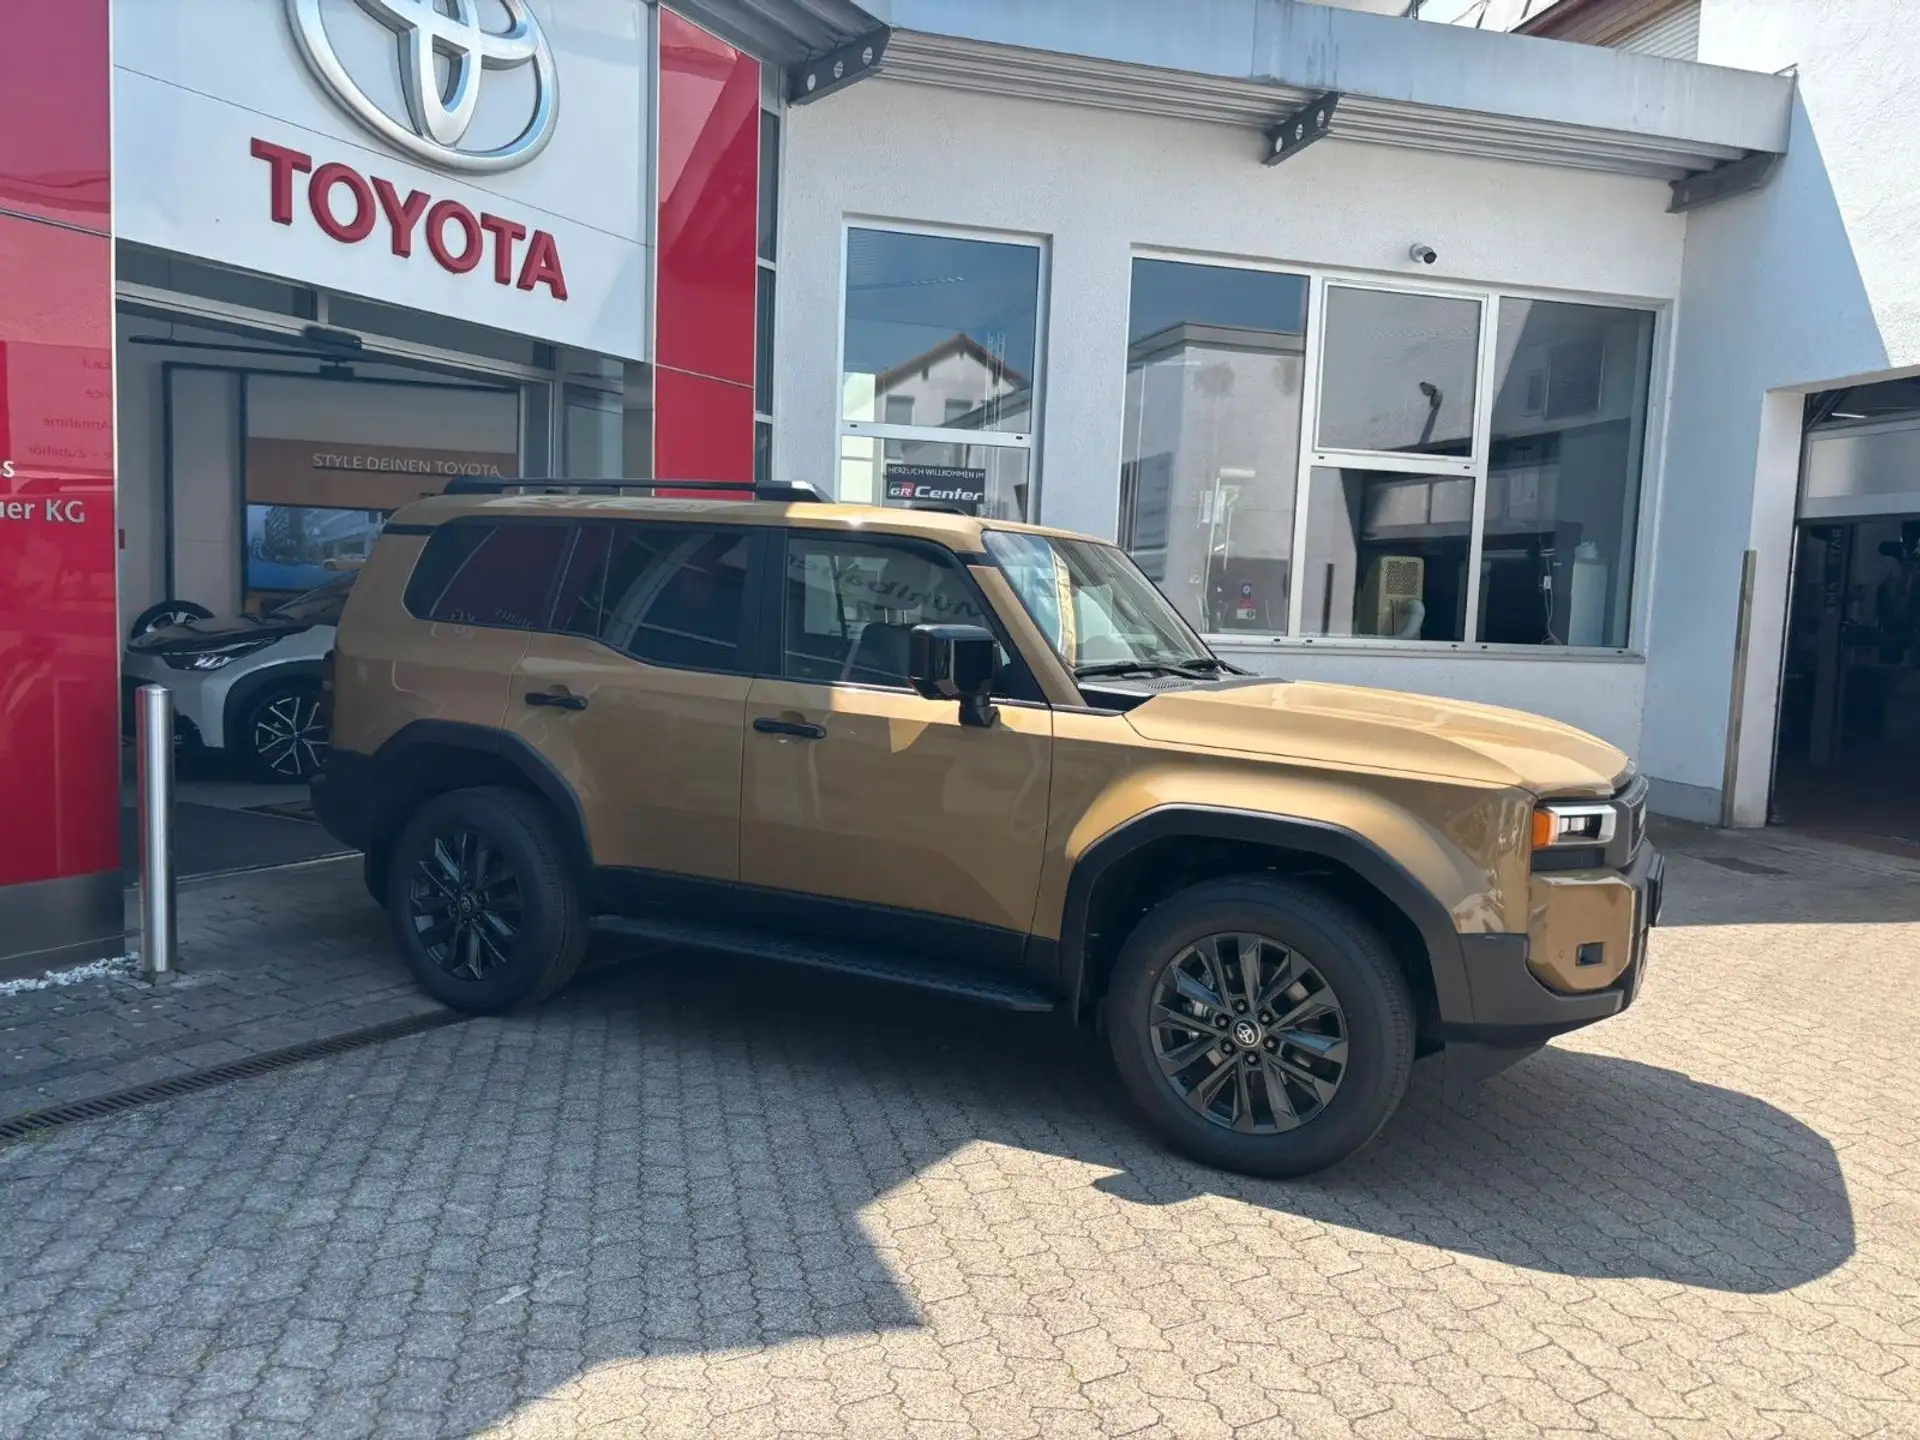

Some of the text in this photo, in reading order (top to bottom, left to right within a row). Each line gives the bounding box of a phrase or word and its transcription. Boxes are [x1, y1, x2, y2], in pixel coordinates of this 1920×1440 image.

[250, 137, 569, 302] TOYOTA
[312, 453, 501, 476] STYLE DEINEN TOYOTA
[888, 466, 985, 479] HERZLICH WILLKOMMEN IM
[890, 485, 984, 501] GR Center
[45, 498, 86, 524] KG
